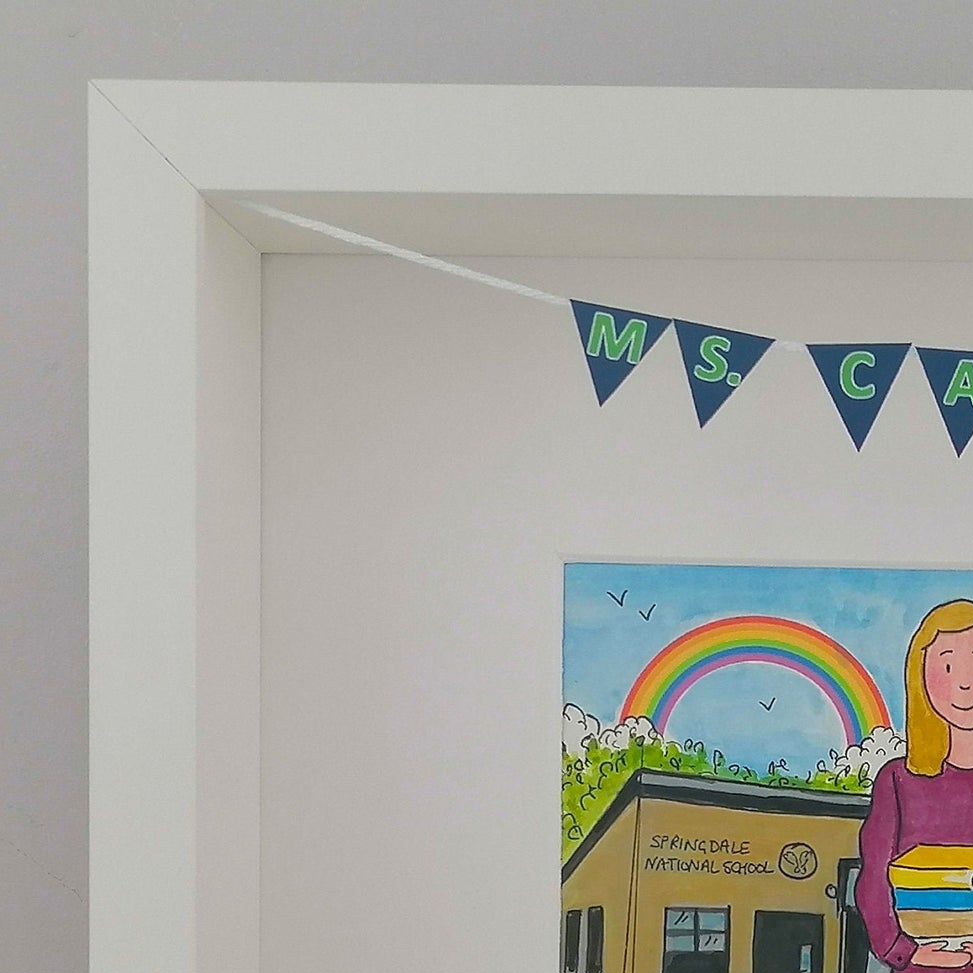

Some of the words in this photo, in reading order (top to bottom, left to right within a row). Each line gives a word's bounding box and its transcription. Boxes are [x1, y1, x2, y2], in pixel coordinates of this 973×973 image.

[586, 312, 742, 388] MS.
[650, 834, 750, 855] SPRINGDALE
[644, 857, 720, 874] NATIONAL
[723, 861, 774, 875] SCHOOL
